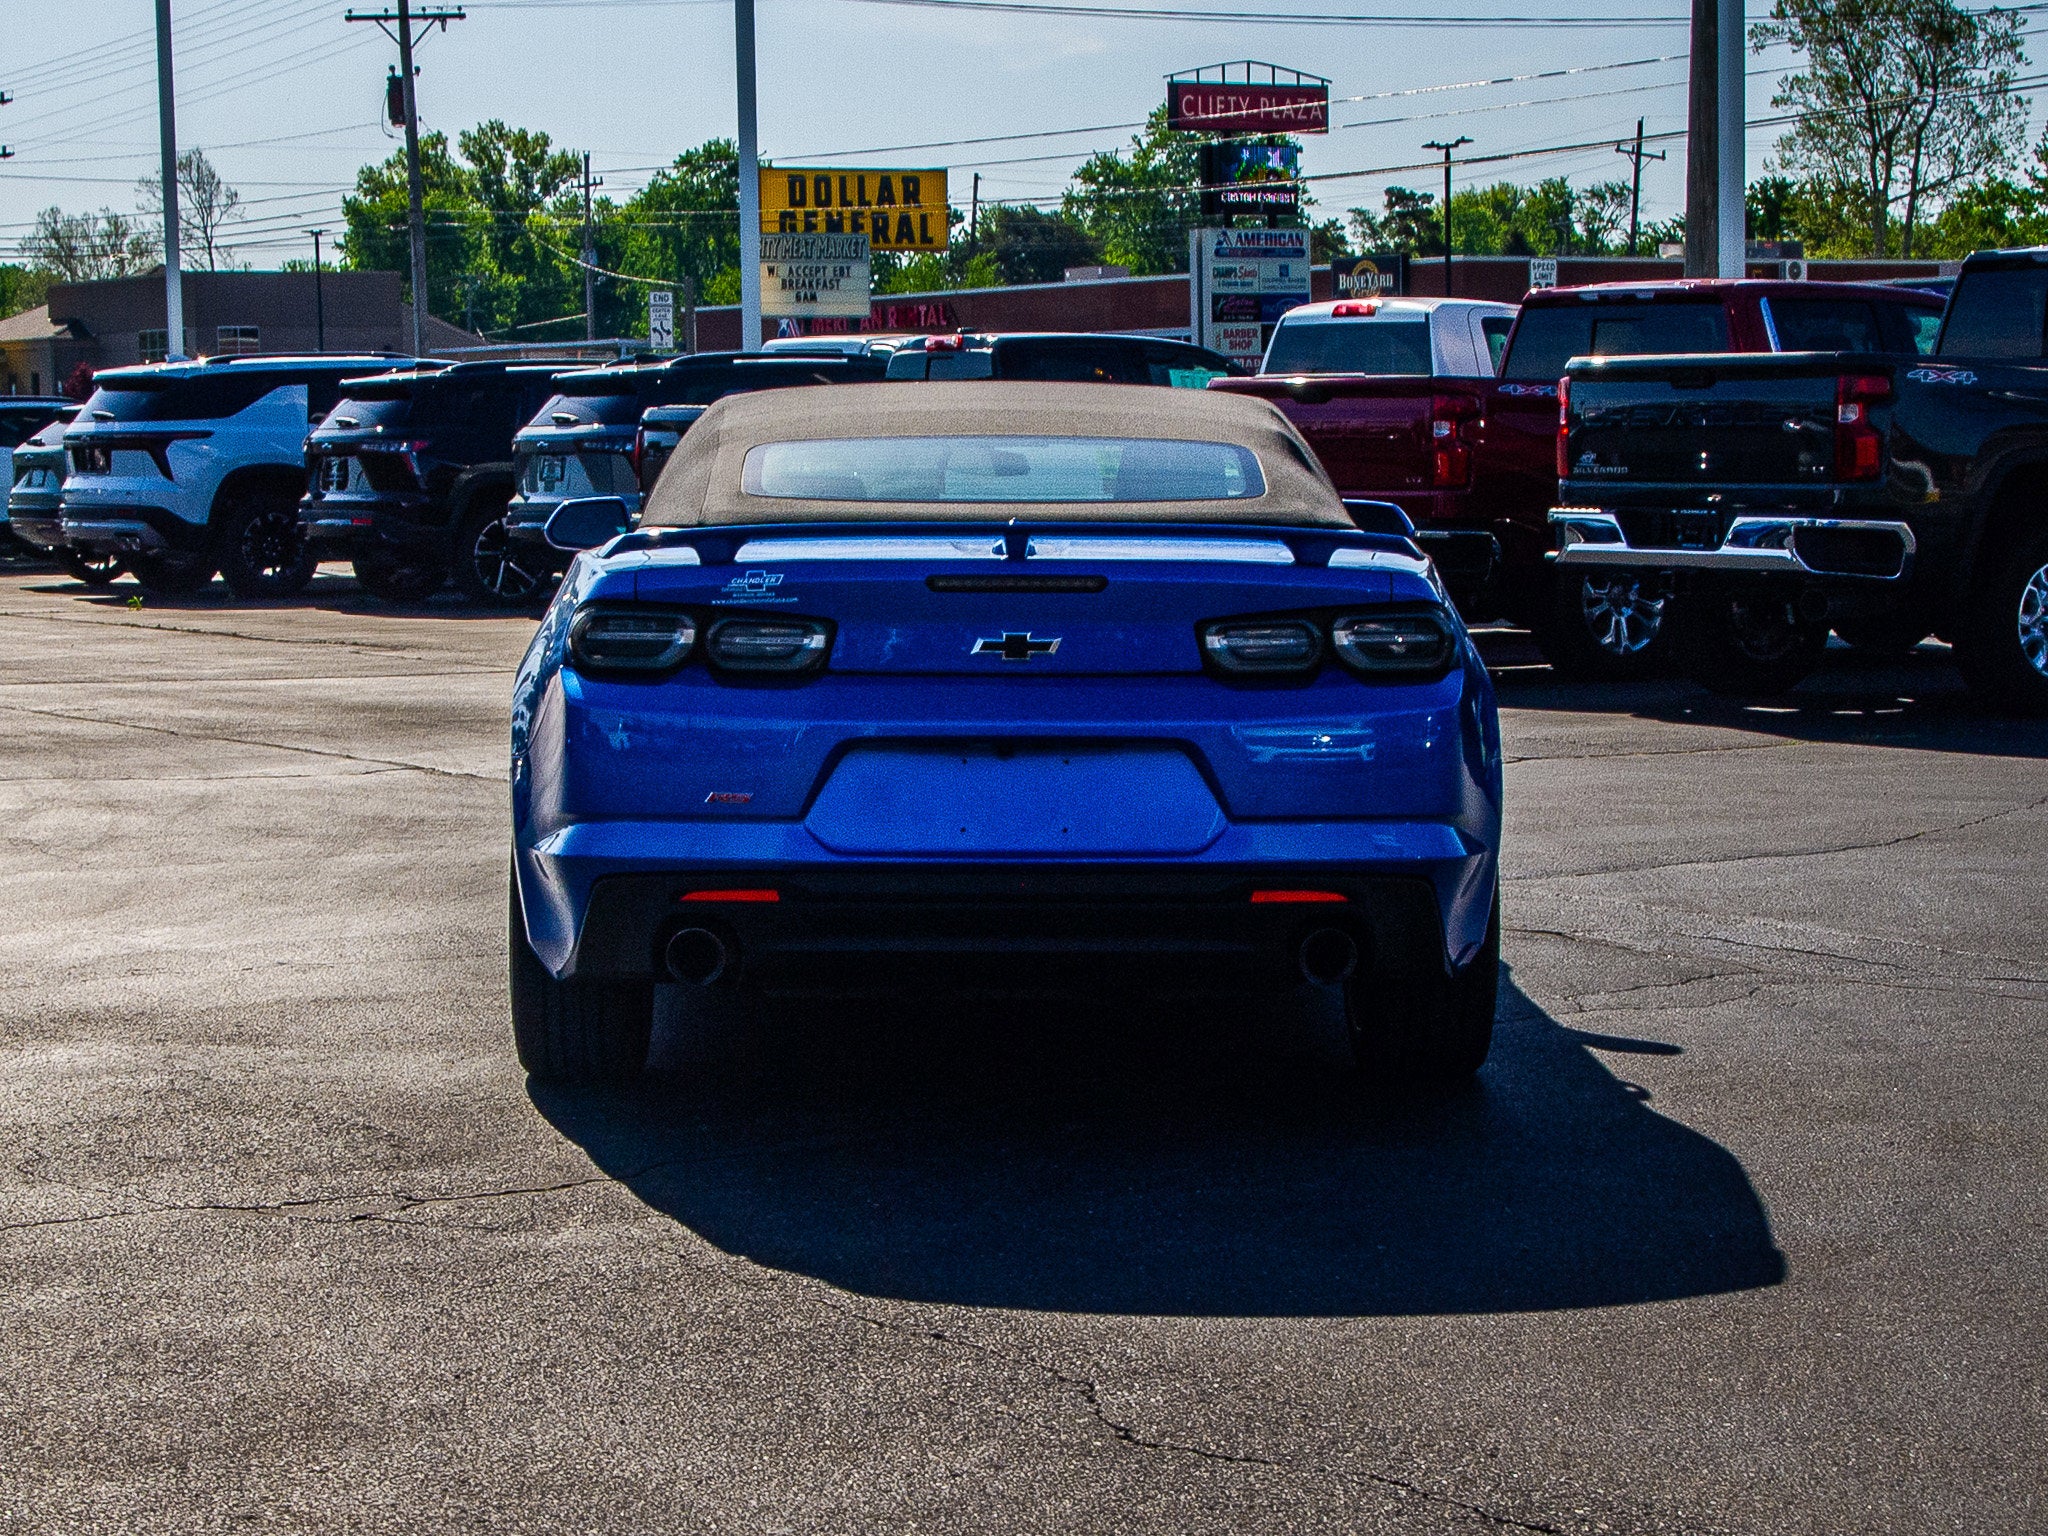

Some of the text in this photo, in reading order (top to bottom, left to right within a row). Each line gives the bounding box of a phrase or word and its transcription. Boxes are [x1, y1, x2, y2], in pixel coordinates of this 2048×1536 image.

[1182, 95, 1323, 121] CLIFTY PLAZA
[787, 174, 922, 208] DOLLAR
[778, 210, 934, 245] GENERAL
[1235, 232, 1304, 247] AMERICAN
[760, 236, 865, 260] ITY MEAT MARKET
[787, 266, 827, 278] ACCEPT
[832, 266, 852, 278] EBT
[1531, 262, 1556, 271] SPEED
[1533, 272, 1553, 281] LIMIT
[780, 279, 841, 291] BREAKFAST
[653, 293, 669, 303] END
[801, 305, 883, 334] MERIAN
[1223, 328, 1258, 340] BARBER
[1229, 339, 1253, 350] SHOP
[731, 576, 778, 585] CHANDLER
